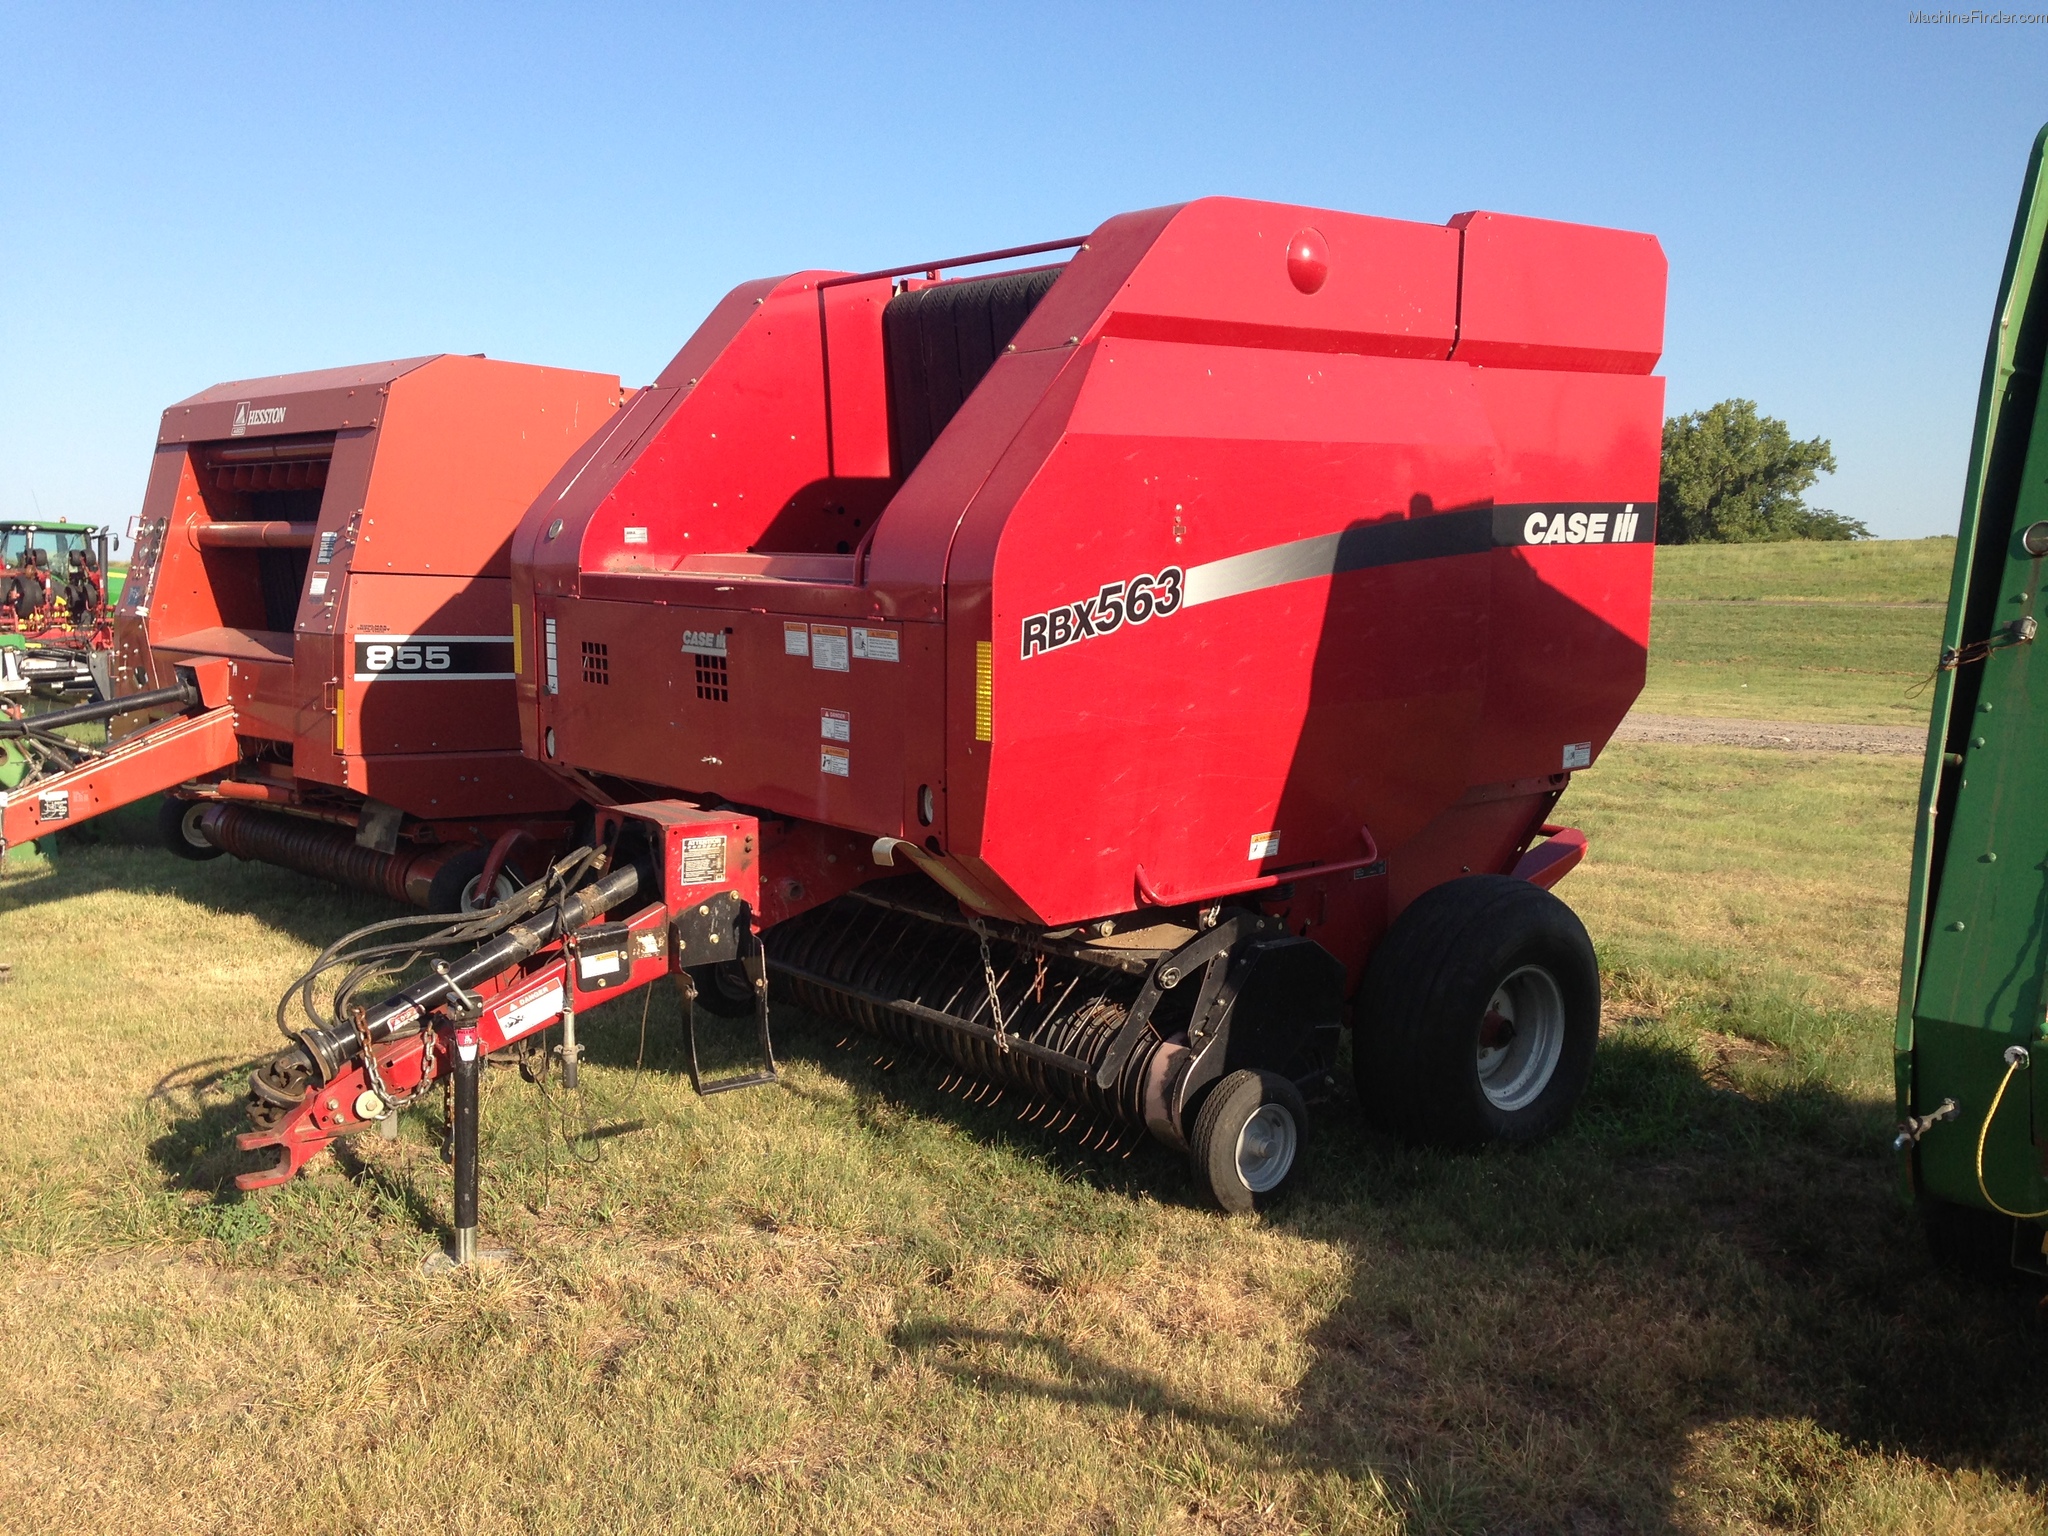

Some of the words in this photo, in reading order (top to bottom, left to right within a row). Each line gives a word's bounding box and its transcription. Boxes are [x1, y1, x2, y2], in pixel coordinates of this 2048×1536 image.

[247, 406, 287, 426] HESSTON
[1523, 511, 1609, 545] CASE
[1021, 565, 1183, 660] RBX563
[682, 630, 715, 647] CASE
[366, 645, 451, 671] 855
[518, 986, 549, 1006] DANGER
